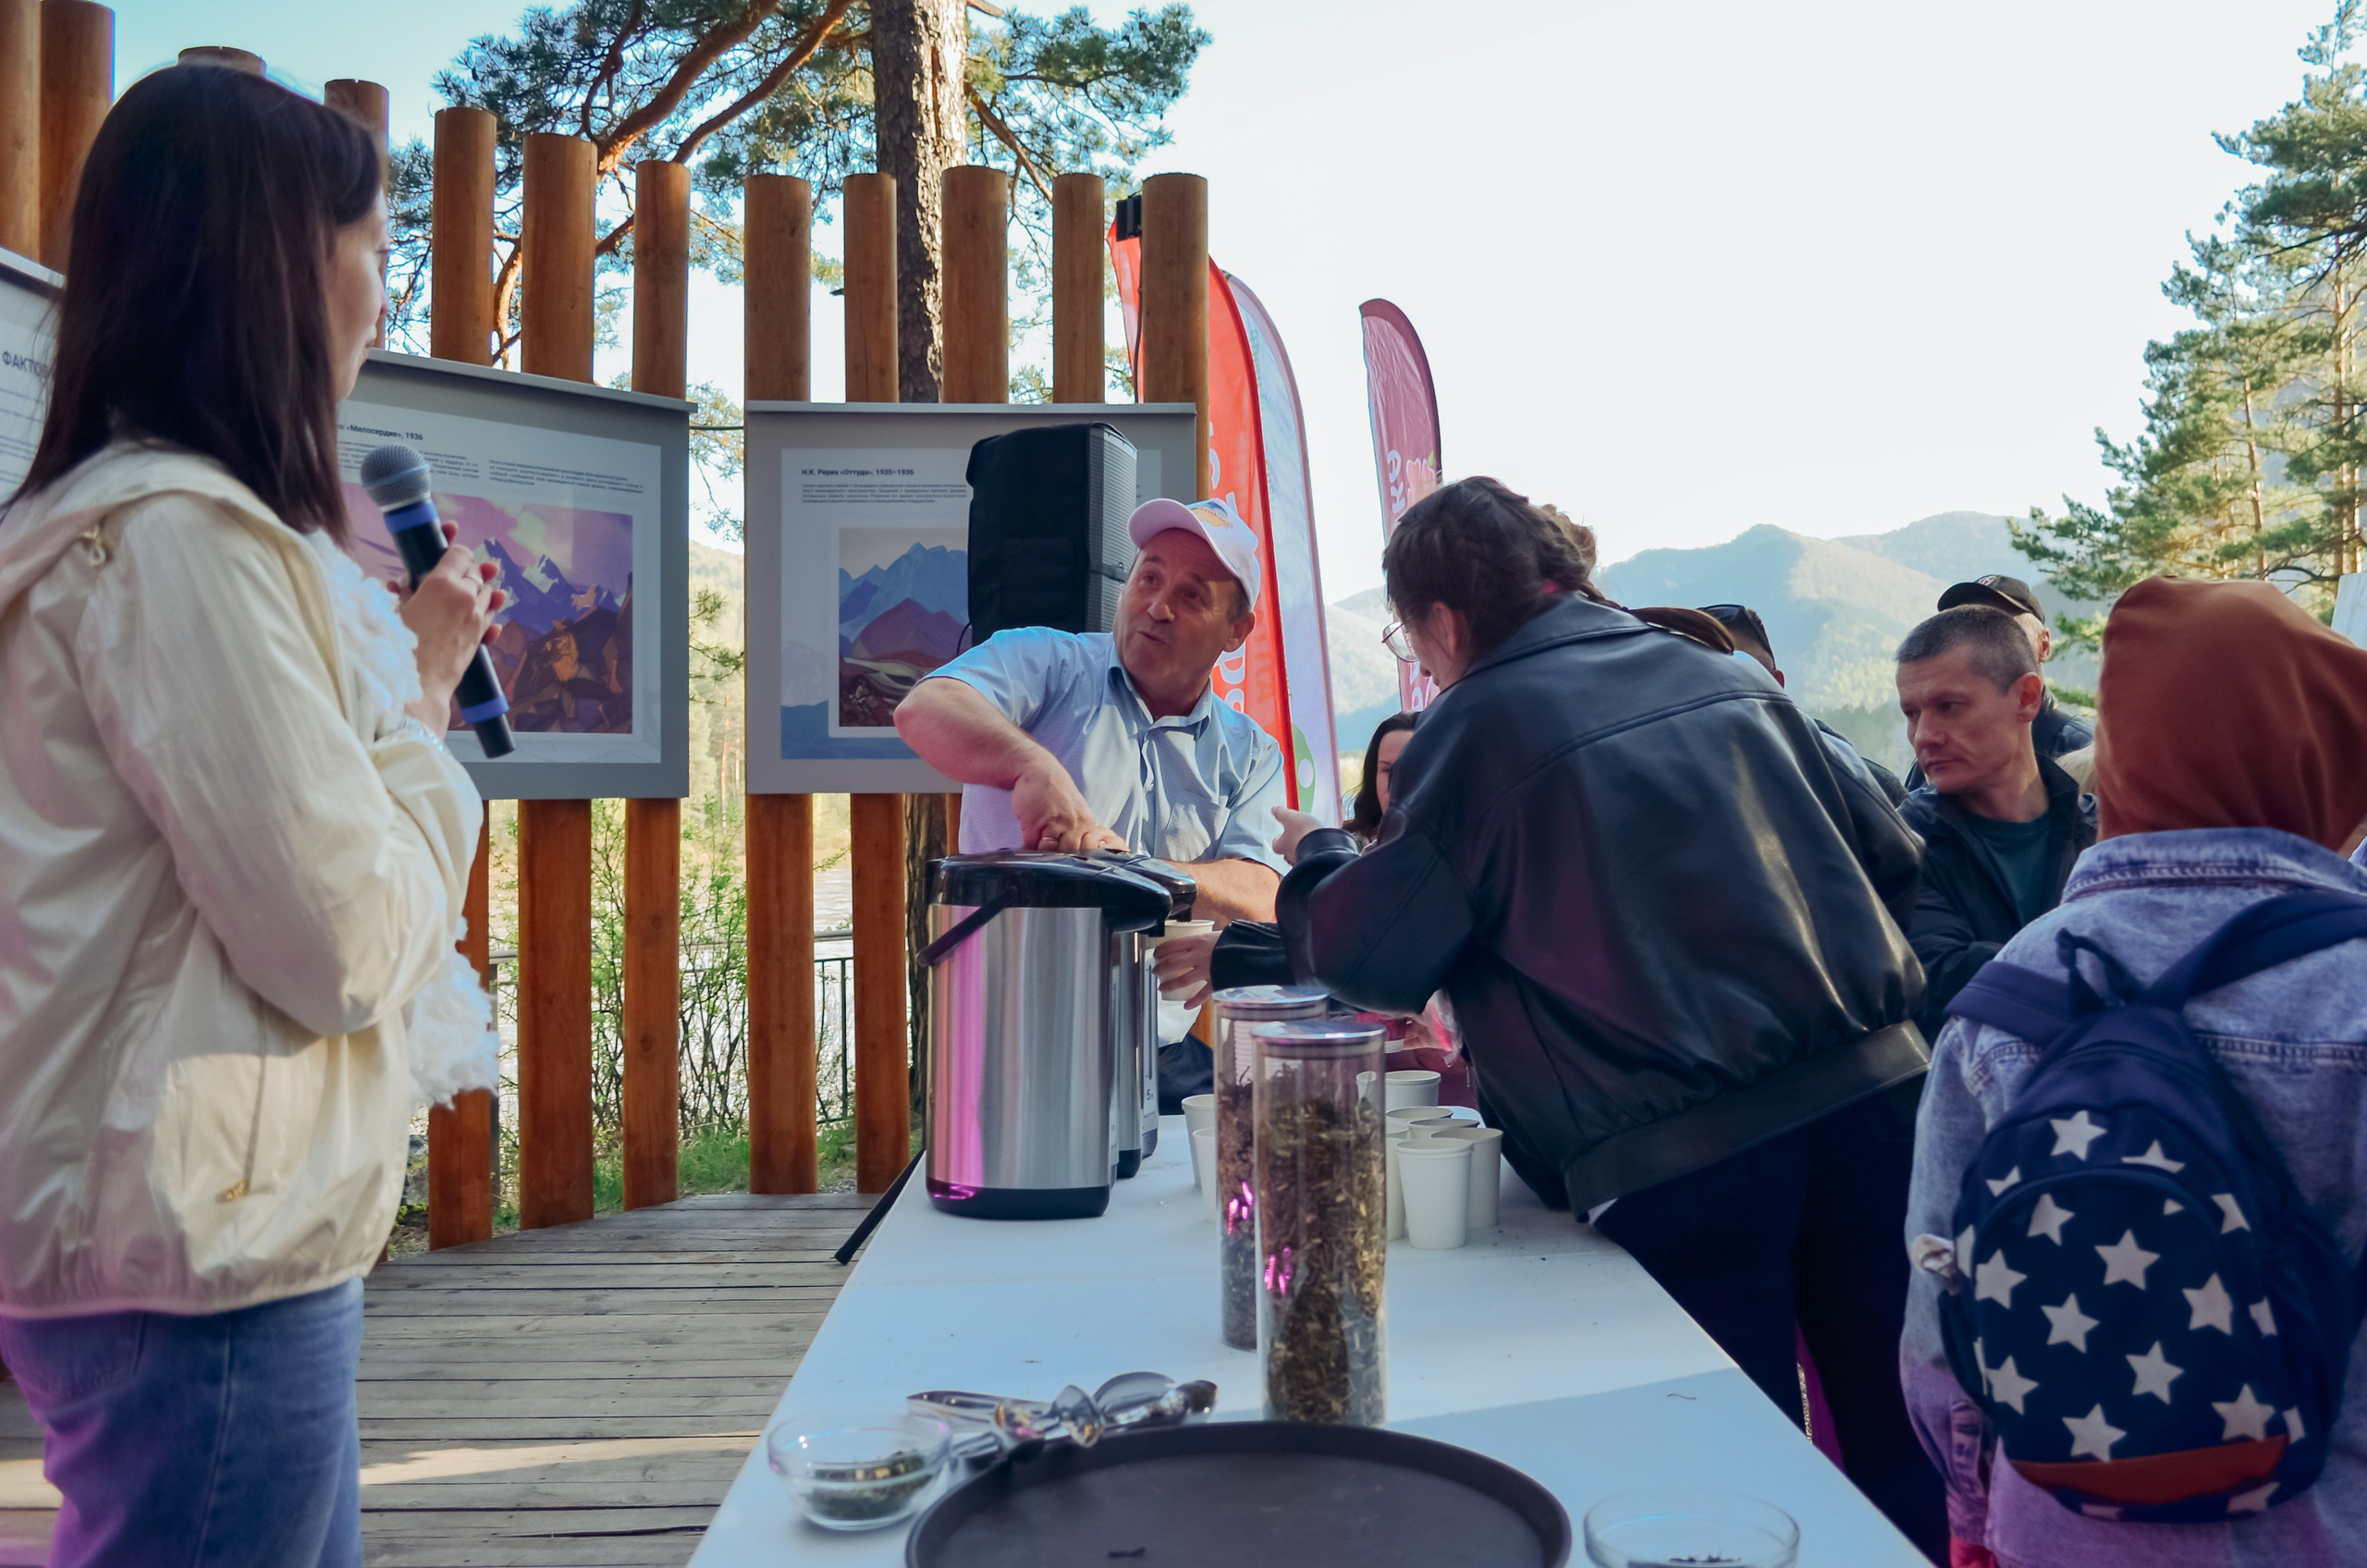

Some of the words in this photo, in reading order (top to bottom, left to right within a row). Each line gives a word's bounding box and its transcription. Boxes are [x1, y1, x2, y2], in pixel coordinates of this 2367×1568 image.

[405, 432, 423, 441] 1936
[817, 469, 839, 477] Рерих
[840, 469, 875, 477] «Оттуда»,
